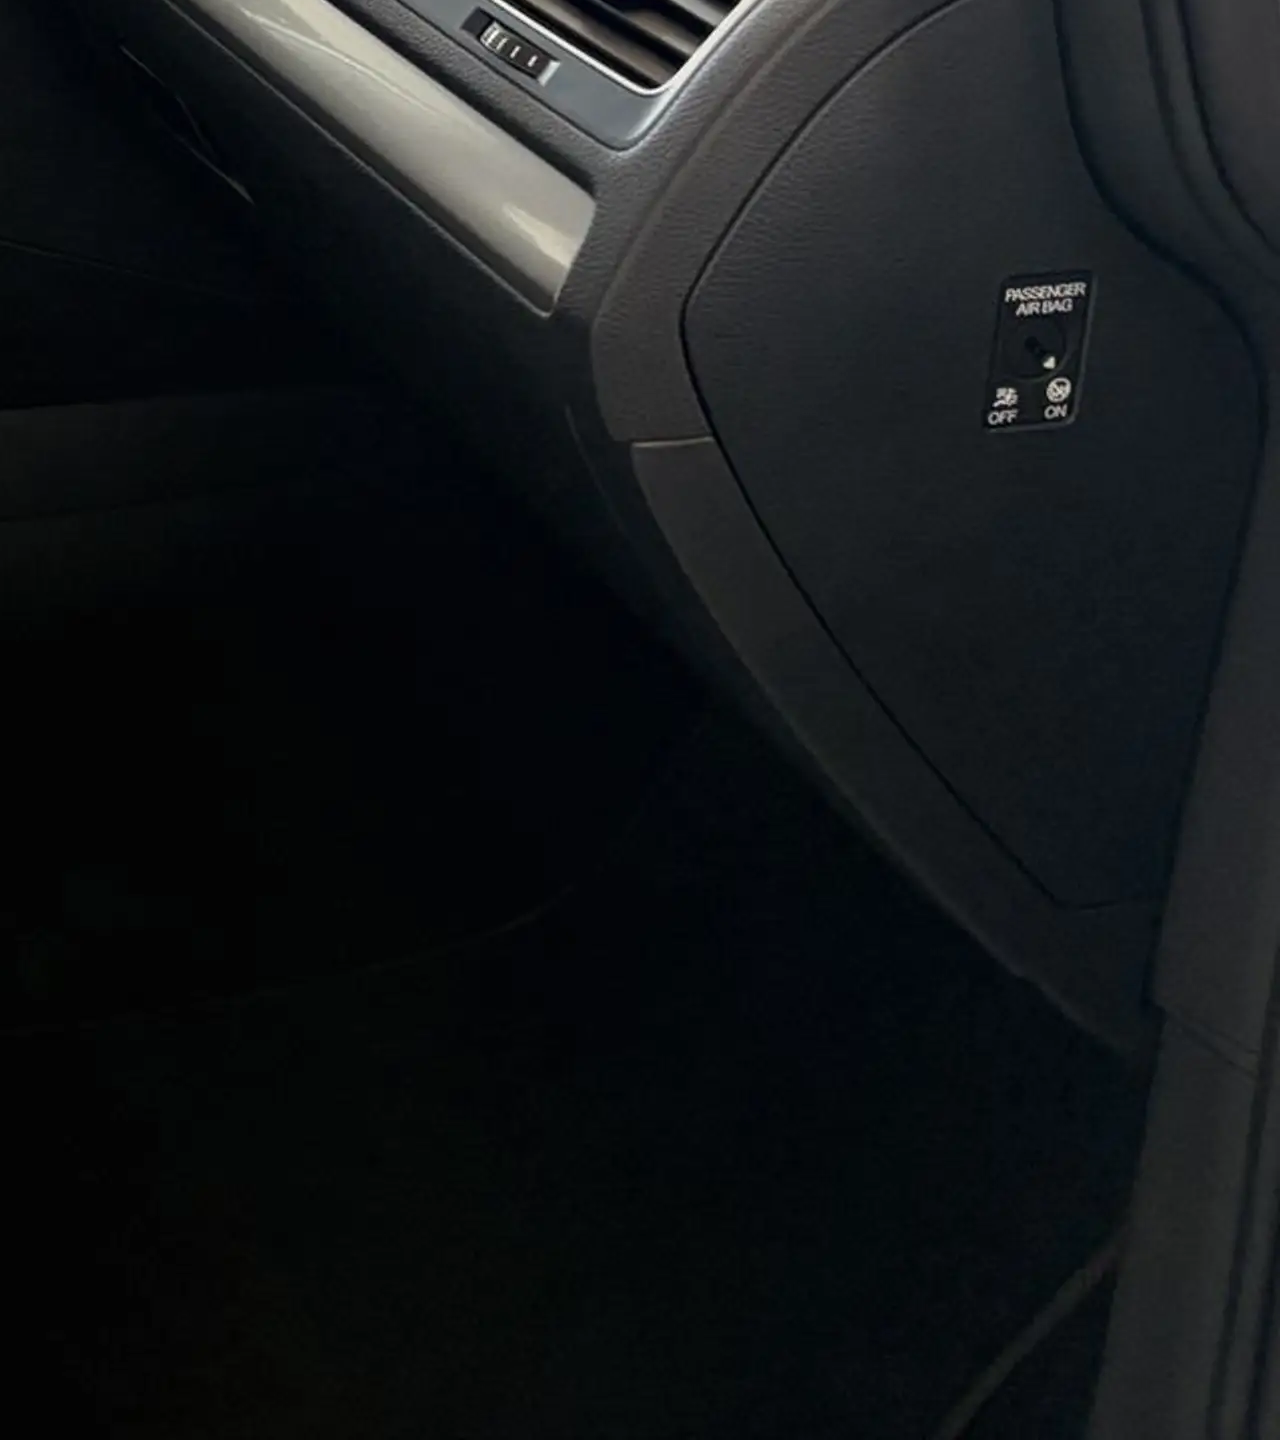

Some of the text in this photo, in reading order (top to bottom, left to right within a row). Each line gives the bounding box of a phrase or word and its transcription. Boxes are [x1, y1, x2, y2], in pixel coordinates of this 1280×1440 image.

[1004, 282, 1086, 302] PASSENGER
[987, 409, 1019, 426] OFF
[1044, 404, 1068, 420] ON
